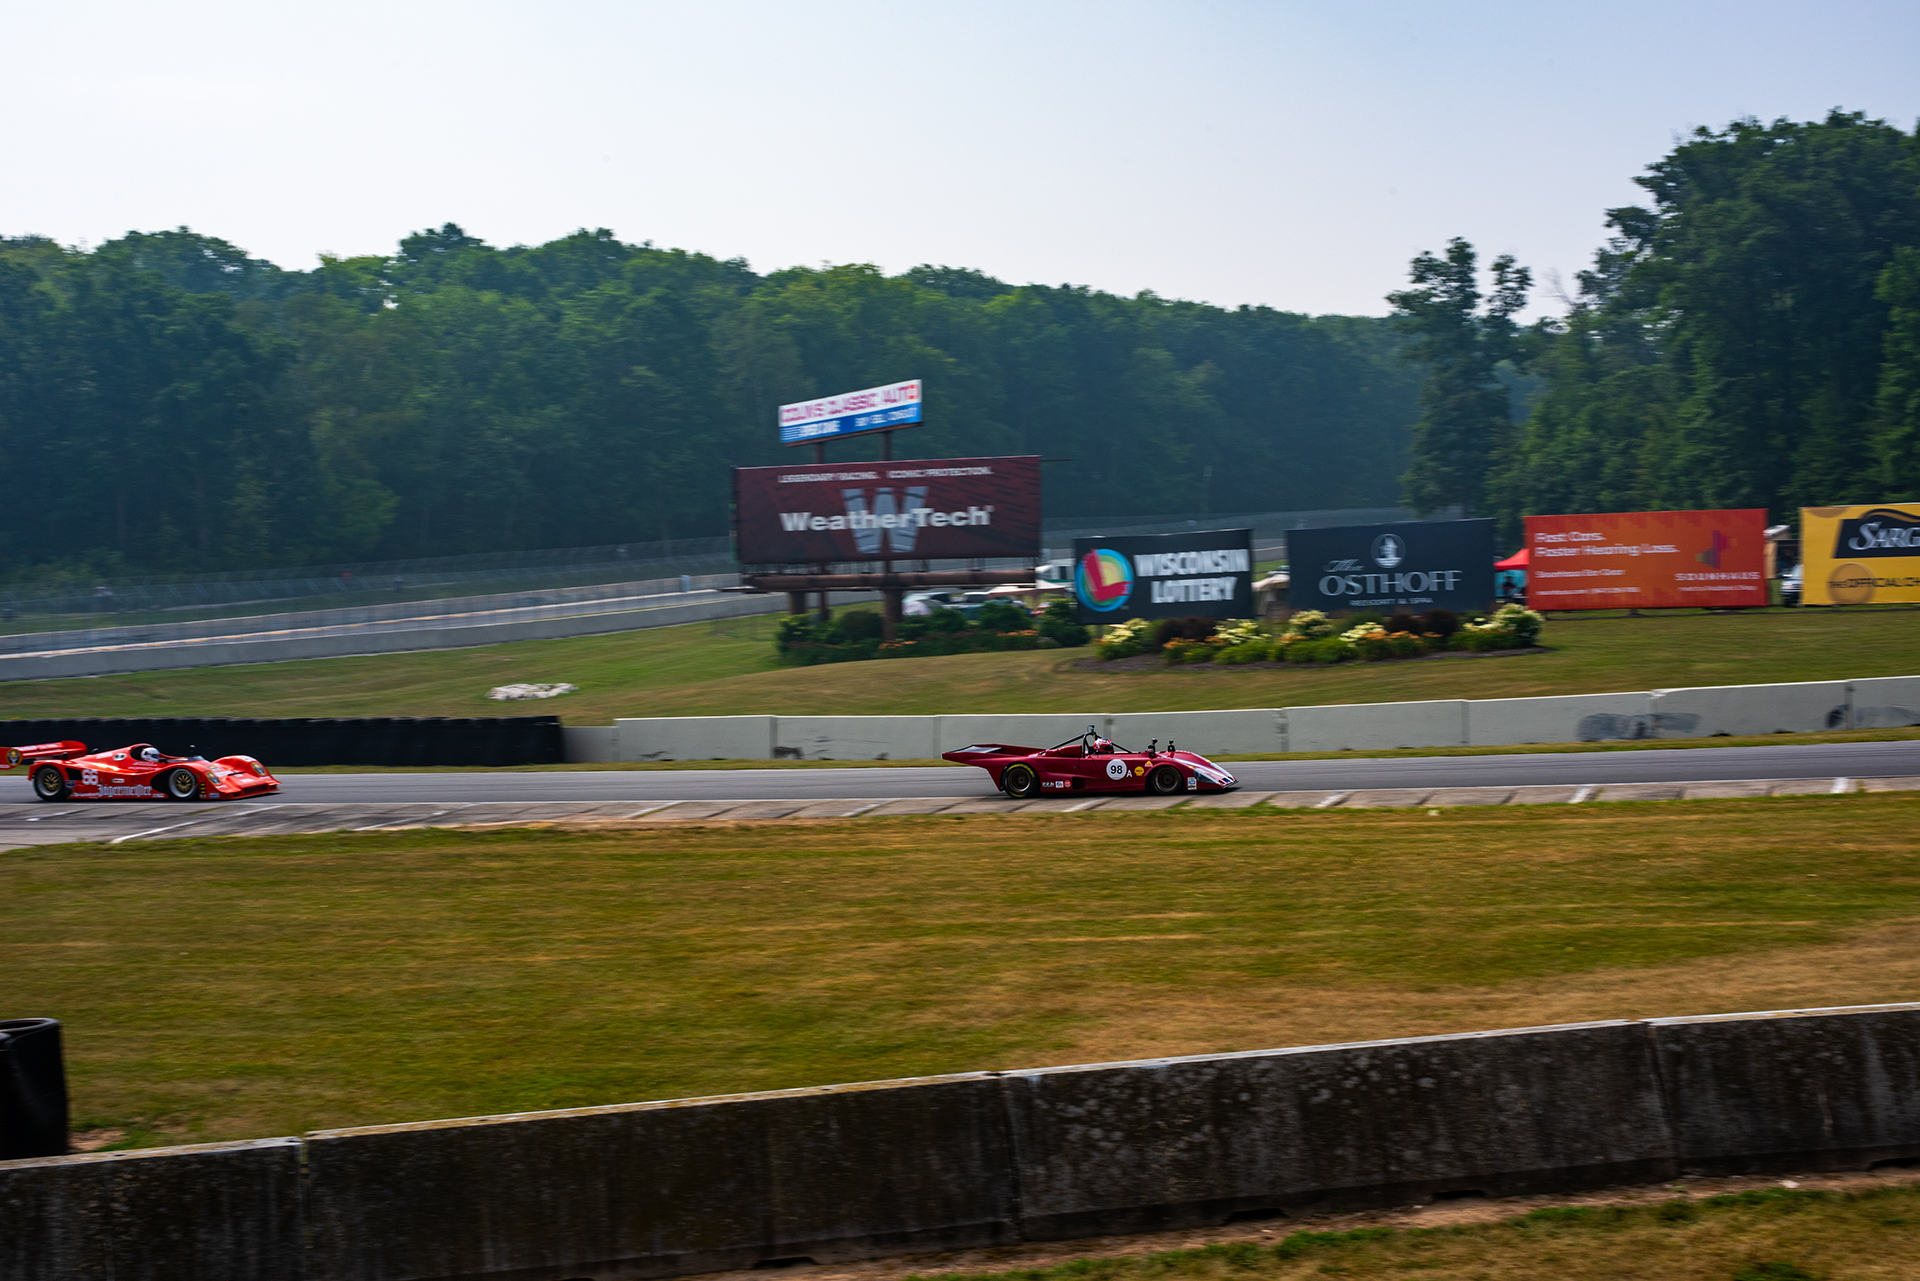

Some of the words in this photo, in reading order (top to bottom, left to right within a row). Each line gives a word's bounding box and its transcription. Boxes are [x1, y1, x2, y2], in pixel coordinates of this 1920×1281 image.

[779, 506, 989, 532] WeatherTech
[1133, 549, 1250, 577] WISCONSIN
[1150, 577, 1238, 603] LOTTERY
[1318, 570, 1463, 596] OSTHOFF
[82, 769, 99, 785] 66
[1110, 765, 1123, 775] 98
[1126, 769, 1133, 777] A
